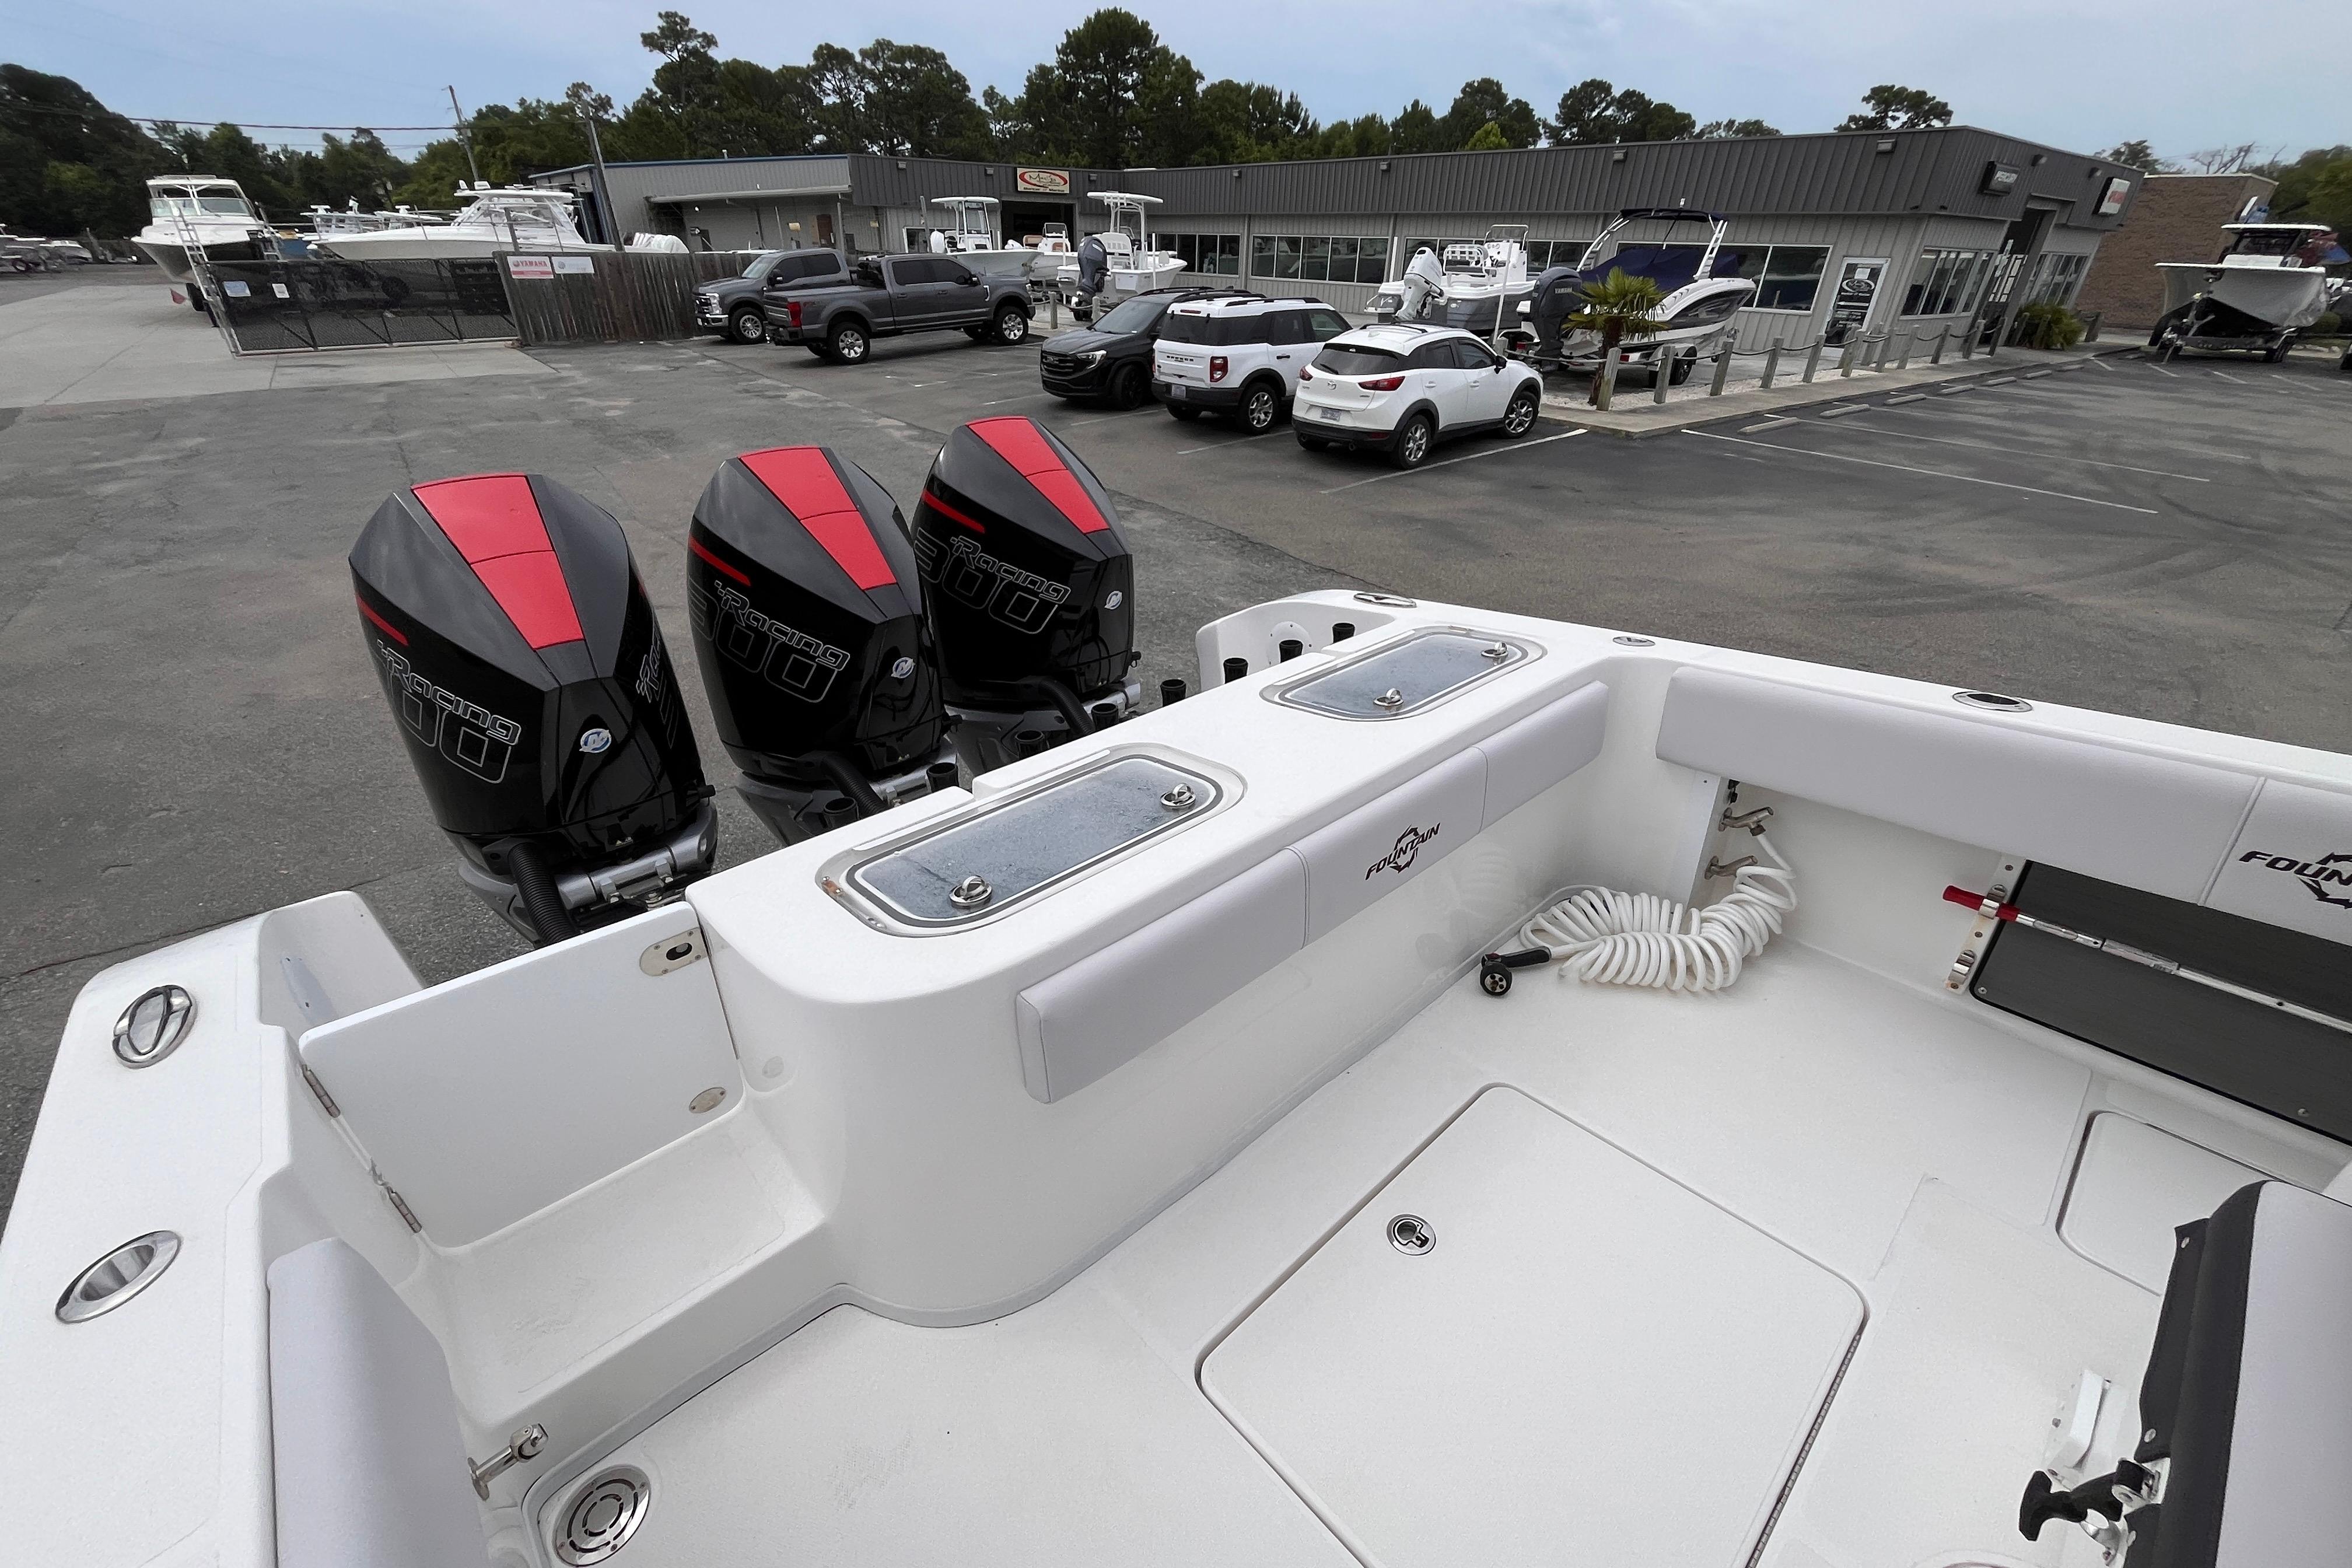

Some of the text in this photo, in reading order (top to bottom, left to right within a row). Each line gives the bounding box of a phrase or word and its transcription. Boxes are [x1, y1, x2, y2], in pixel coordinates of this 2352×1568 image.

[951, 535, 1072, 605] Racing
[720, 586, 850, 671] Racing
[385, 646, 522, 746] Racing
[1364, 821, 1441, 881] FOUNTAIN
